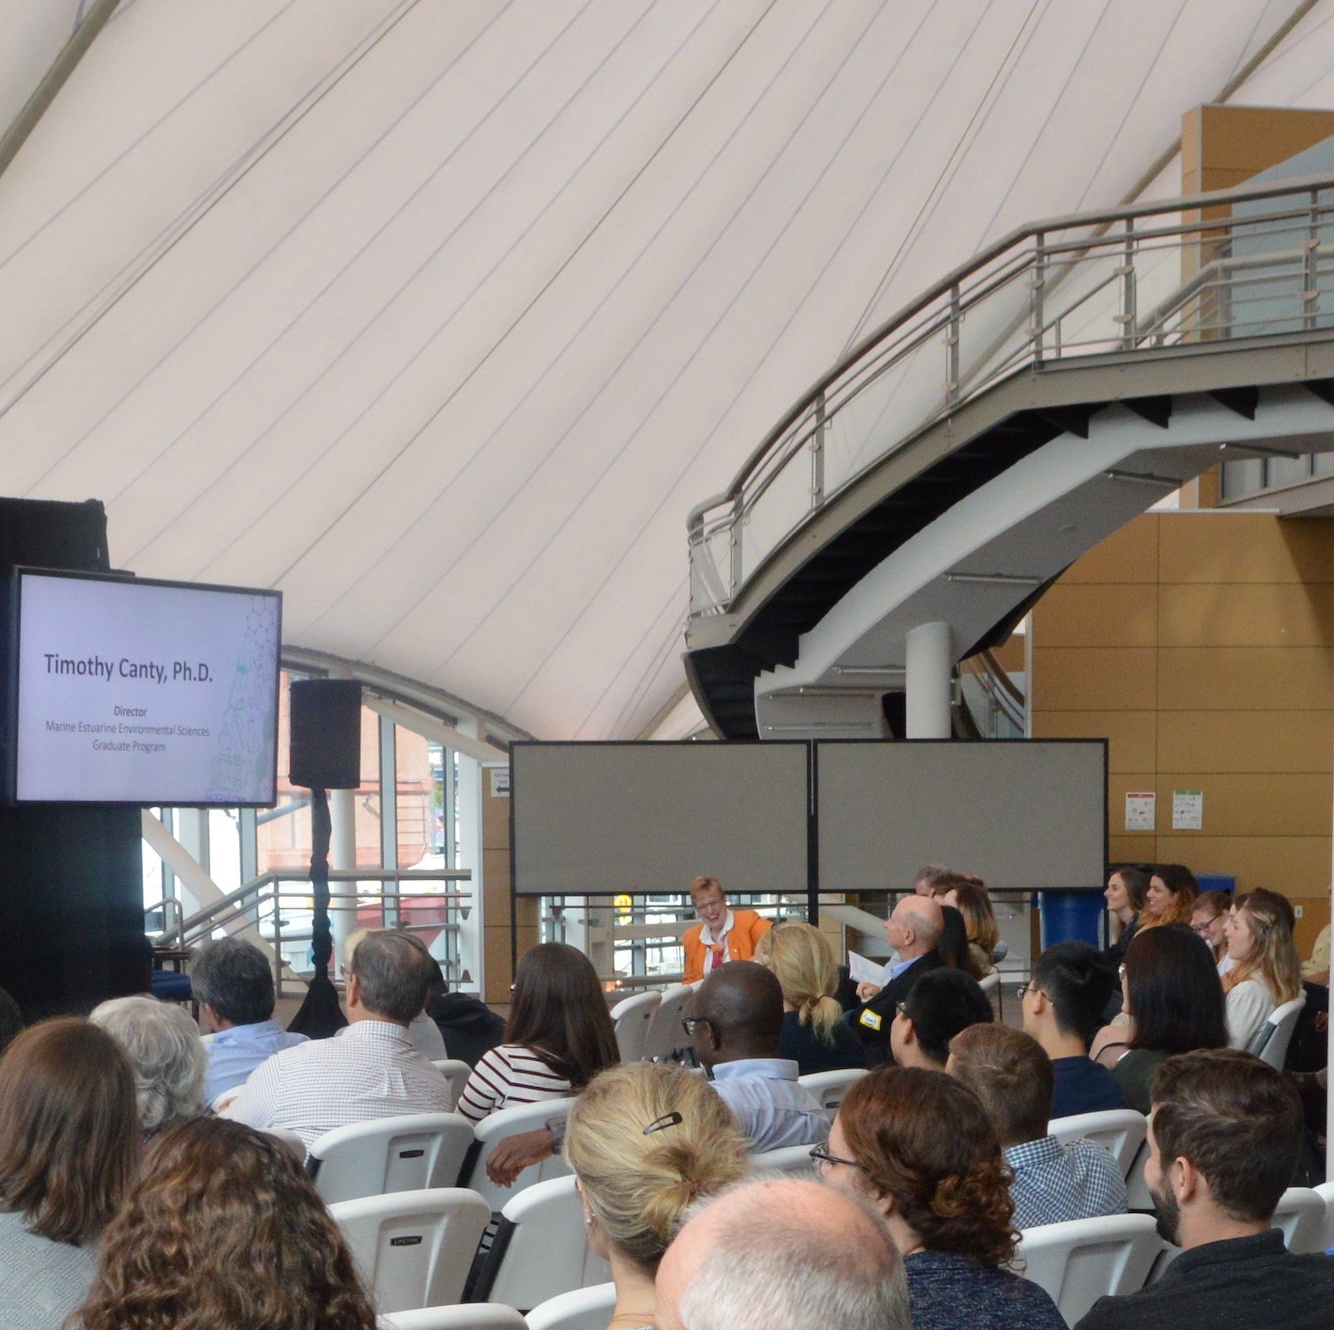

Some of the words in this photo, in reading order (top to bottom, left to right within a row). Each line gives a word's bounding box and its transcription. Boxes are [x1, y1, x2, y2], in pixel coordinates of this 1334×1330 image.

[44, 653, 114, 682] Timothy
[119, 658, 168, 684] Canty,
[173, 661, 213, 682] Ph.D.
[114, 705, 147, 717] Director
[46, 720, 76, 732] Marine
[78, 721, 116, 733] Estuarine
[118, 723, 175, 735] Environmental
[177, 725, 210, 736] Sciences
[92, 739, 130, 751] Graduate
[132, 741, 166, 753] Program
